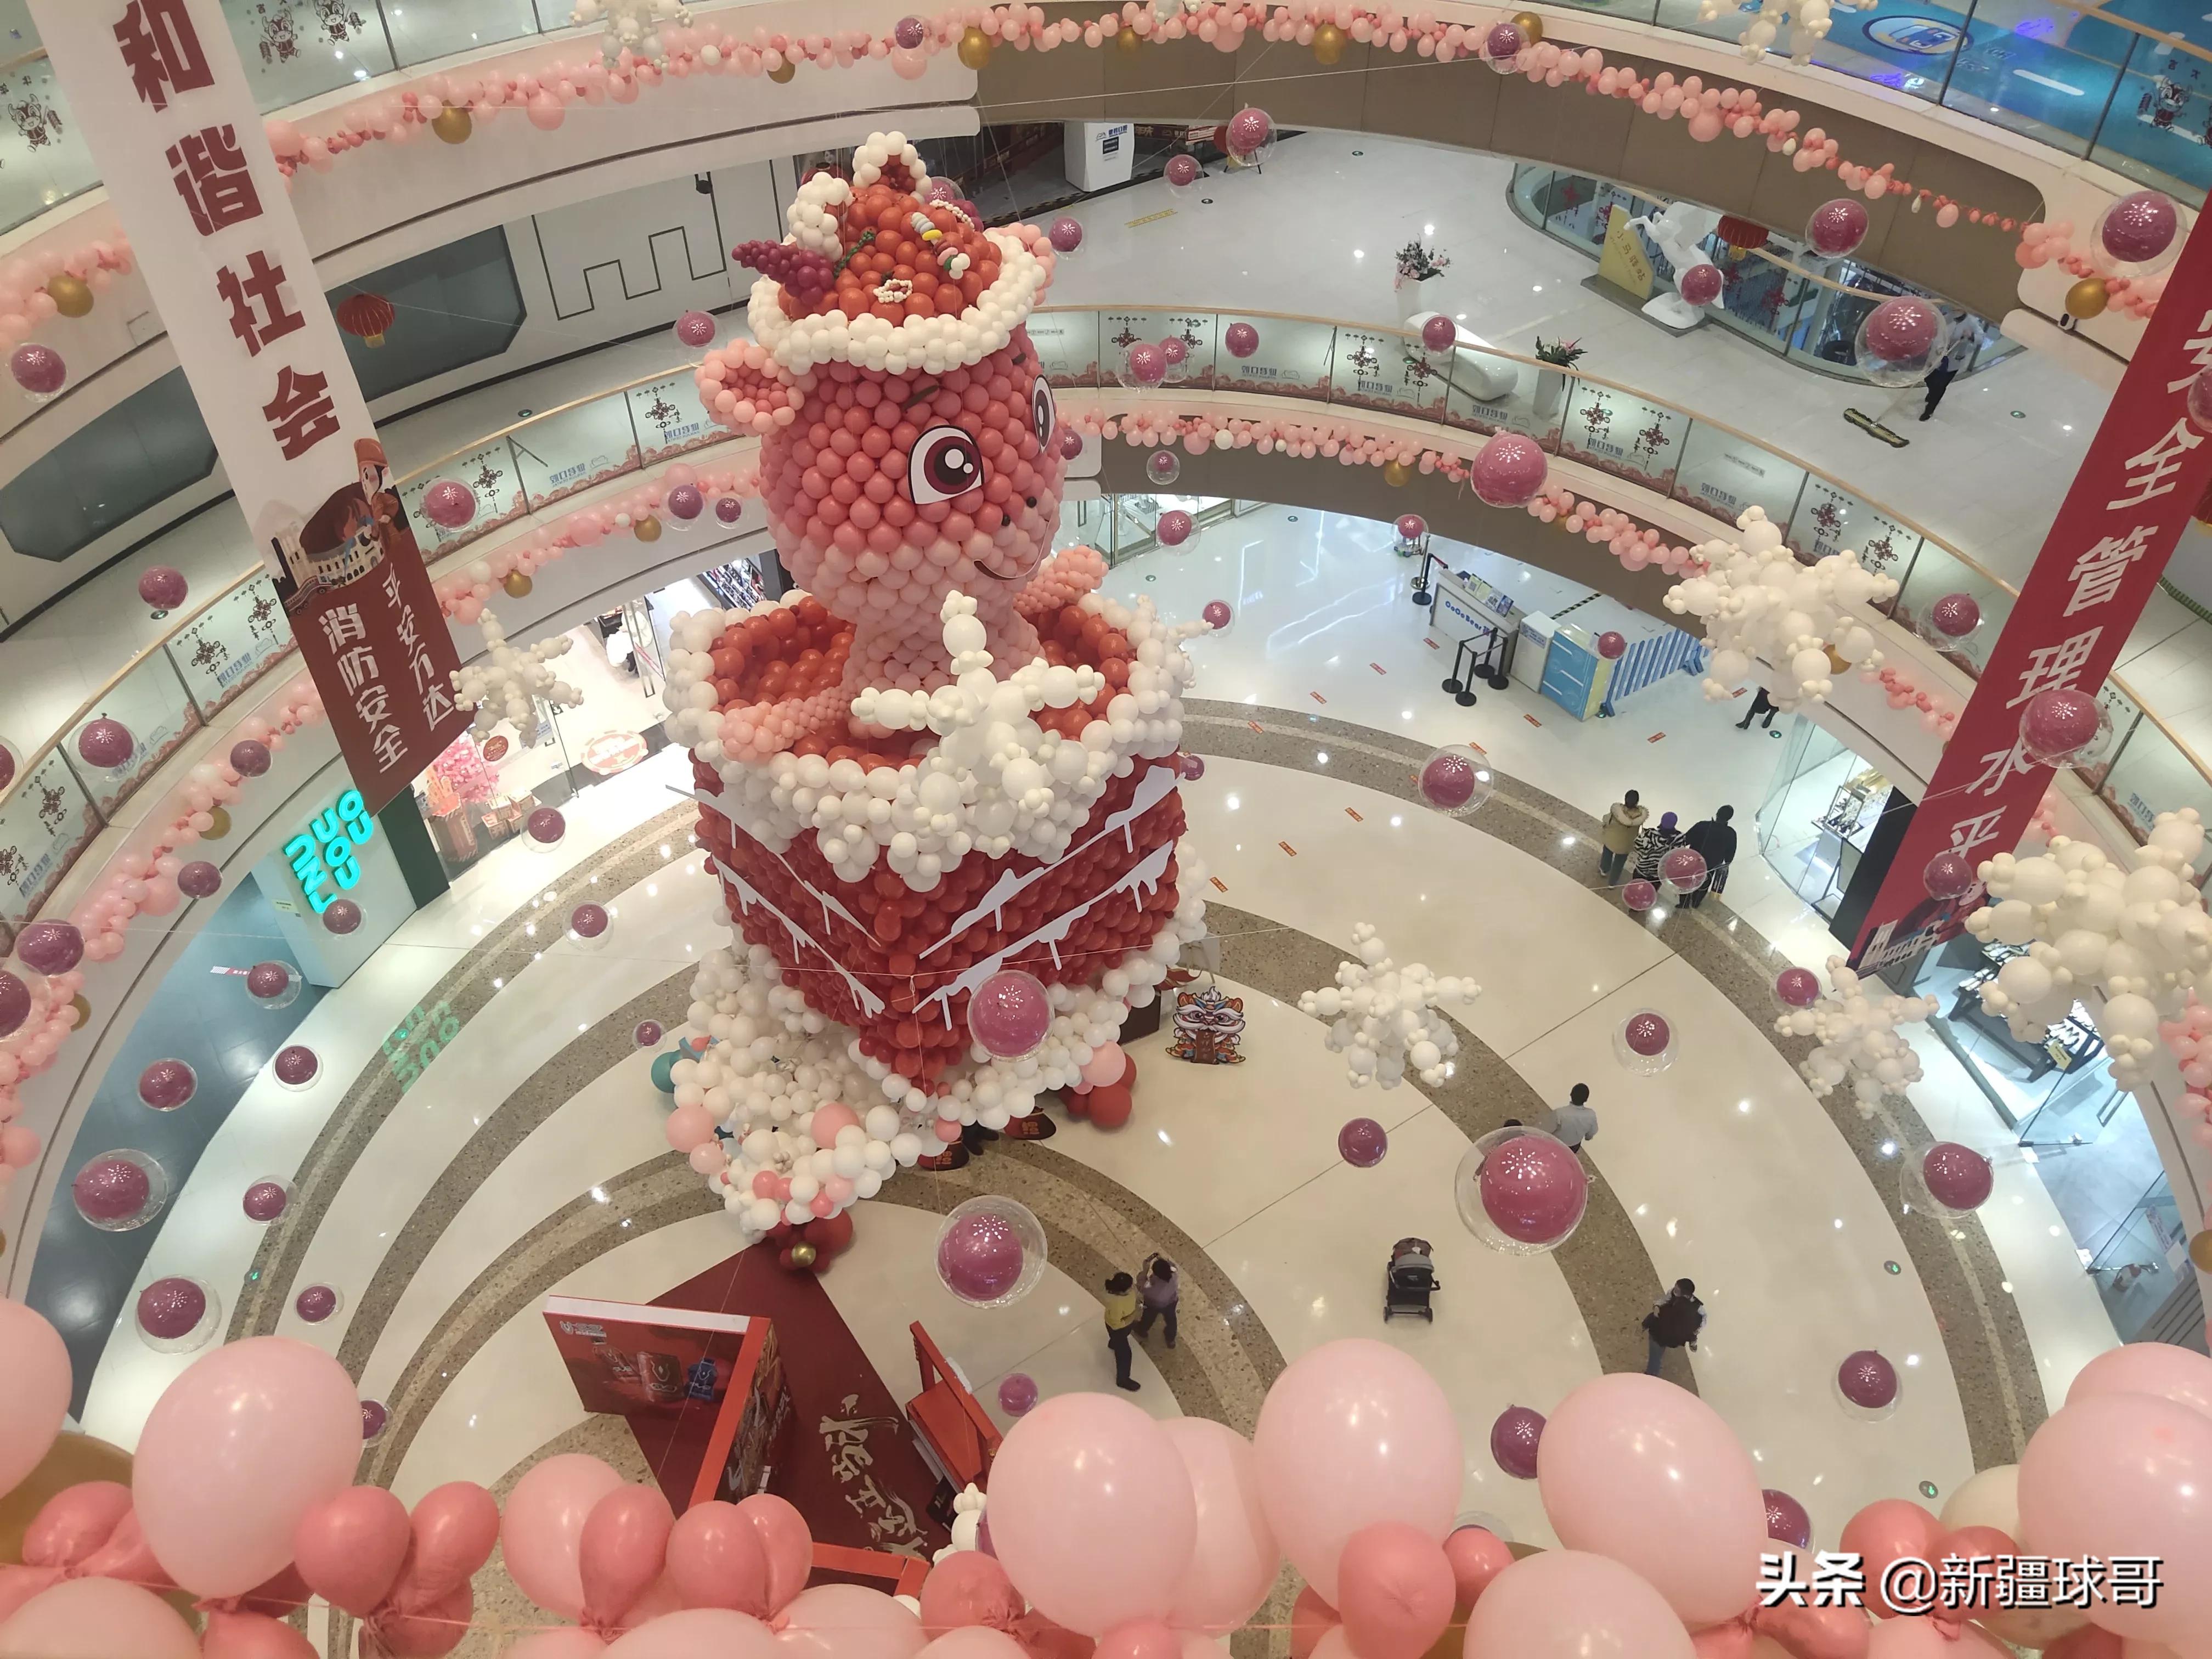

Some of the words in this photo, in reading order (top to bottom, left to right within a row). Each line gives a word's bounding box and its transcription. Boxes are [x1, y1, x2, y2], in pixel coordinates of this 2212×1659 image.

[114, 0, 340, 460] 和谐社会
[318, 603, 408, 775] 消防安全
[382, 562, 454, 731] 平安万达
[285, 790, 364, 869] DUO
[296, 812, 374, 894] ZOU
